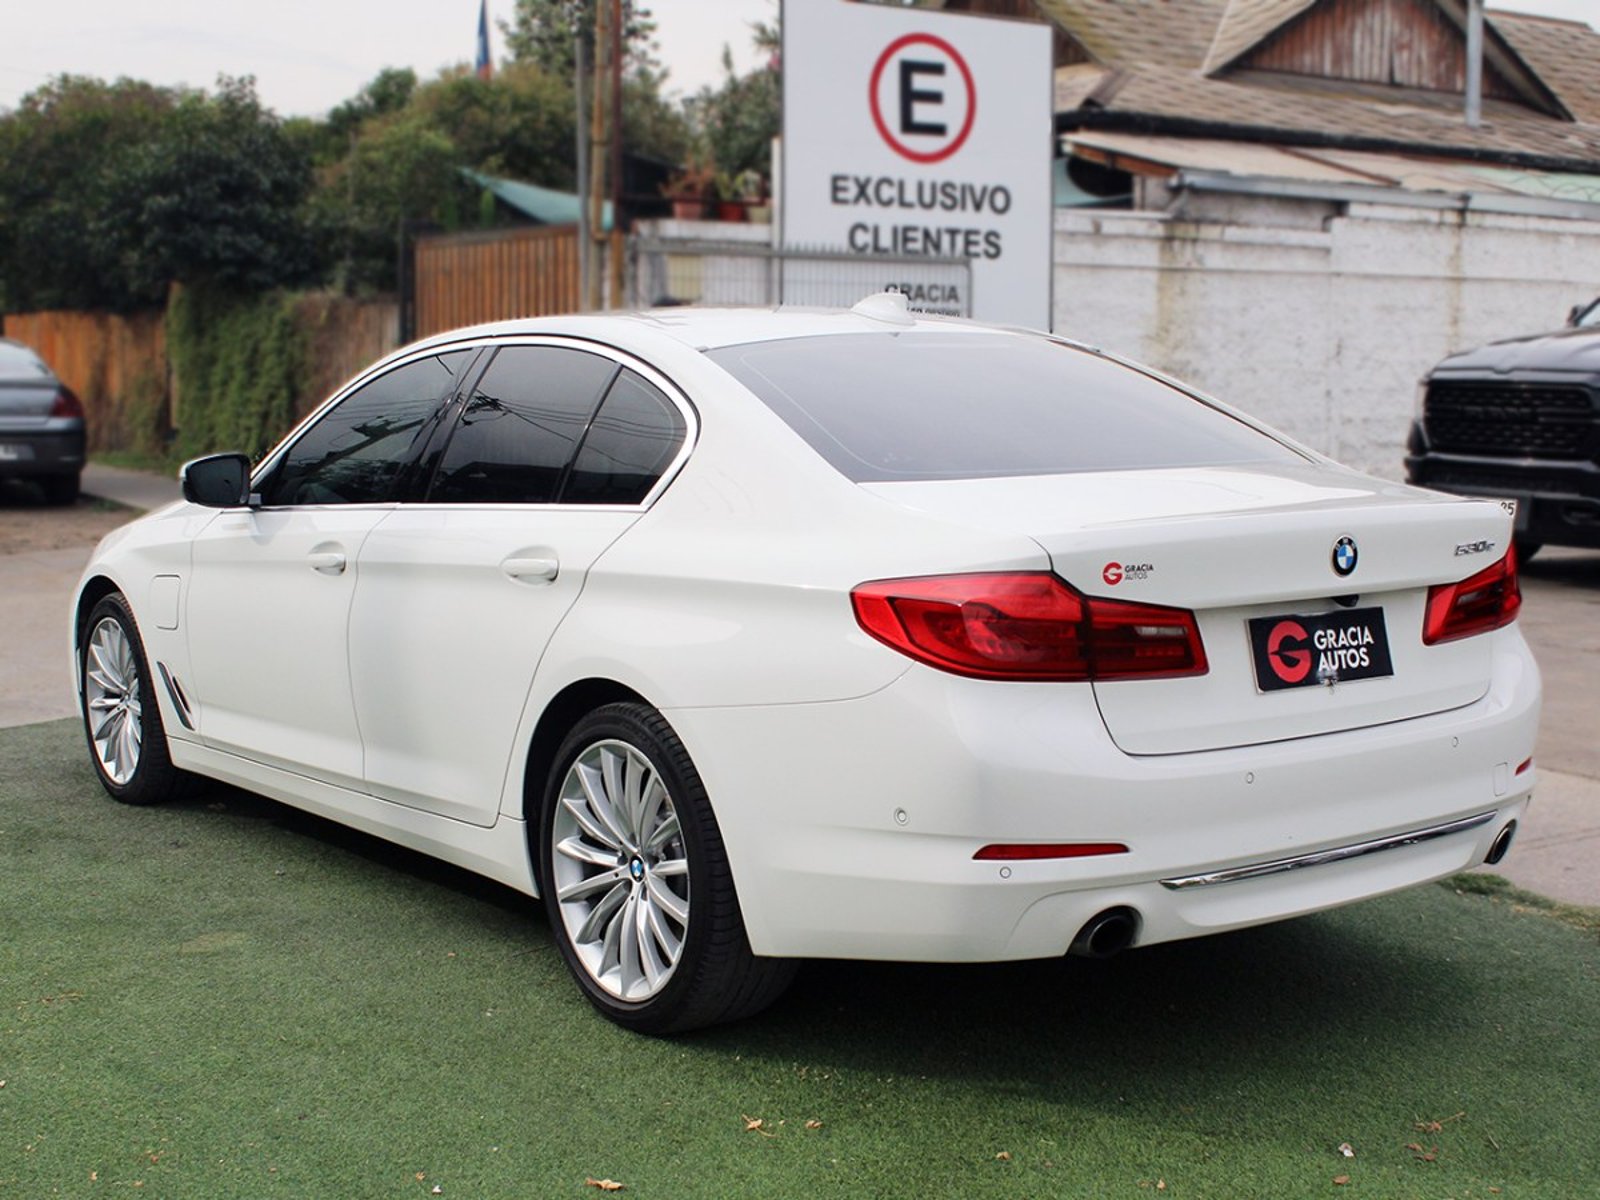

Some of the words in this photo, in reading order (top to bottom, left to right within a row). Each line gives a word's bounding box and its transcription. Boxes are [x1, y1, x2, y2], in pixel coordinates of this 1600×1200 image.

[899, 58, 947, 136] E
[831, 174, 1012, 215] EXCLUSIVO
[848, 223, 1002, 260] CLIENTES
[1124, 563, 1154, 573] GRACIA
[1313, 625, 1374, 650] GRACIA
[1319, 647, 1370, 671] AUTOS
